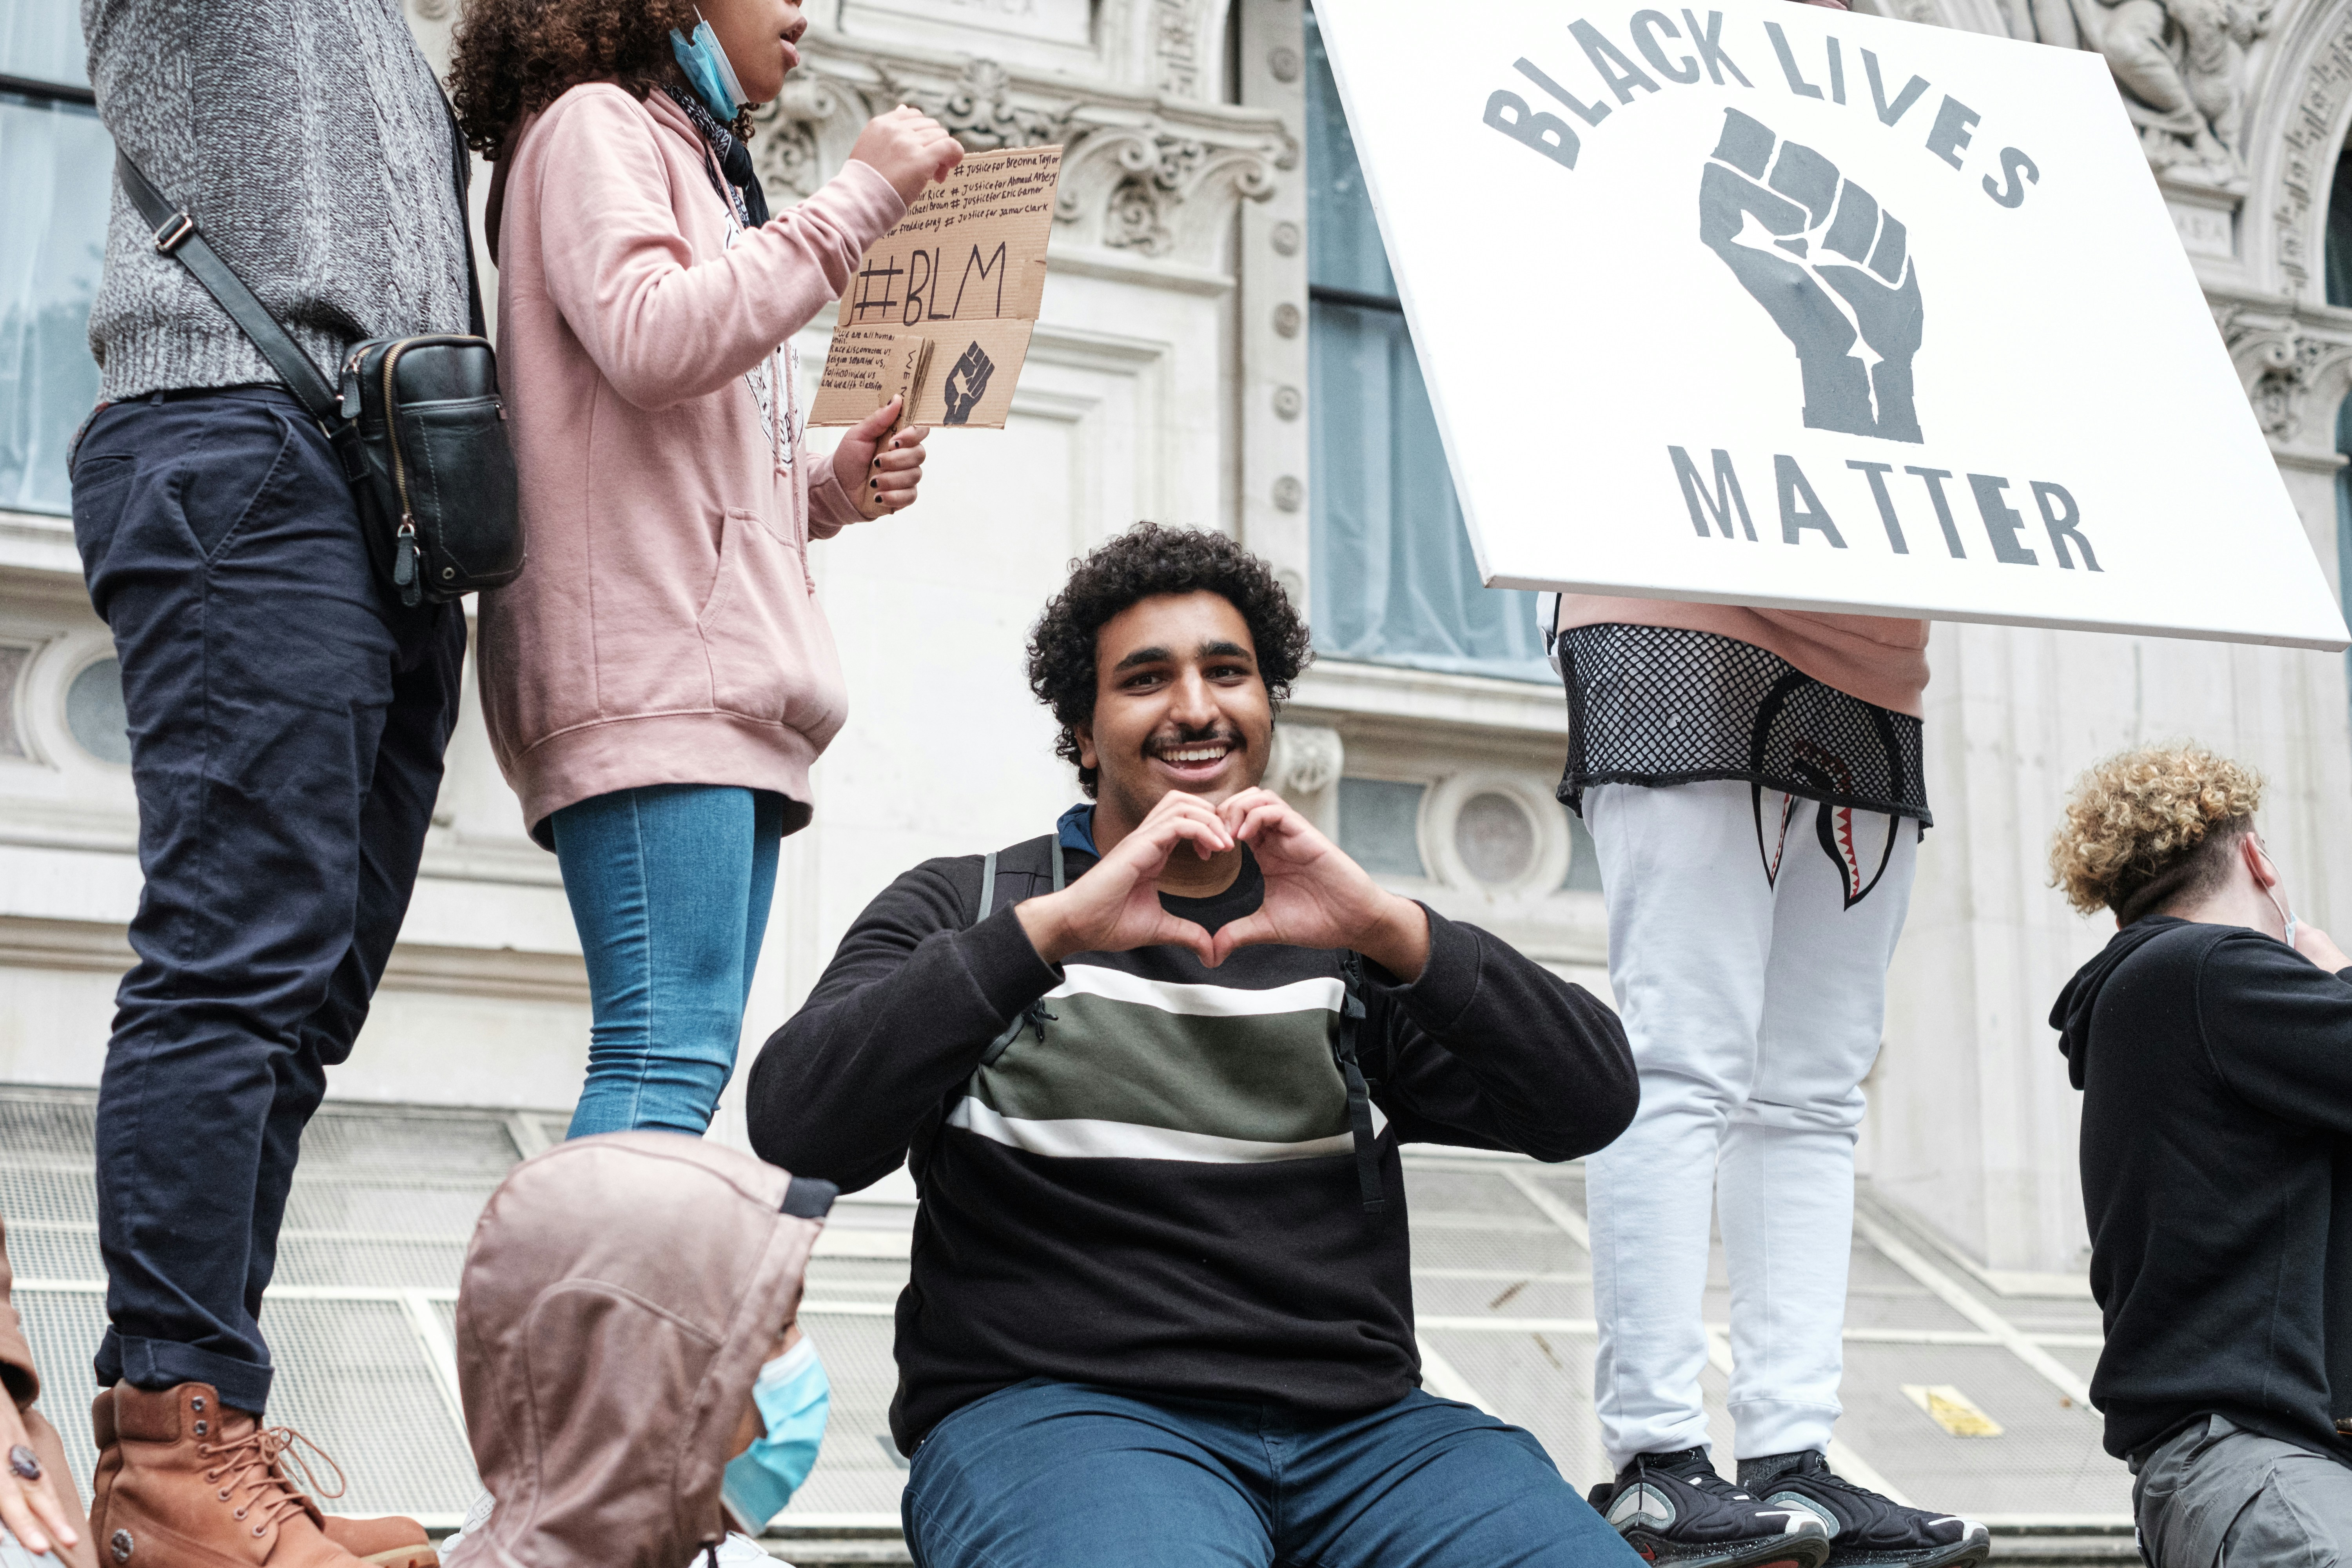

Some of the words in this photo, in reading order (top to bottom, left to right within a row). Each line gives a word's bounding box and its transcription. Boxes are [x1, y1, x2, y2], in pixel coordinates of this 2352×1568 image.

[1483, 9, 1755, 171] BLACK
[1763, 21, 2040, 209] LIVES
[1006, 157, 1037, 169] Breonna
[1039, 154, 1060, 169] Taylor
[1007, 173, 1033, 187] Ahmaud
[1033, 172, 1057, 187] Arbery
[929, 201, 948, 211] Brown
[1002, 189, 1016, 199] Eric
[925, 217, 941, 232] Gray
[1025, 203, 1048, 212] Clark
[855, 241, 1005, 327] #BLM
[829, 344, 846, 353] Race
[1667, 445, 2105, 572] MATTER
